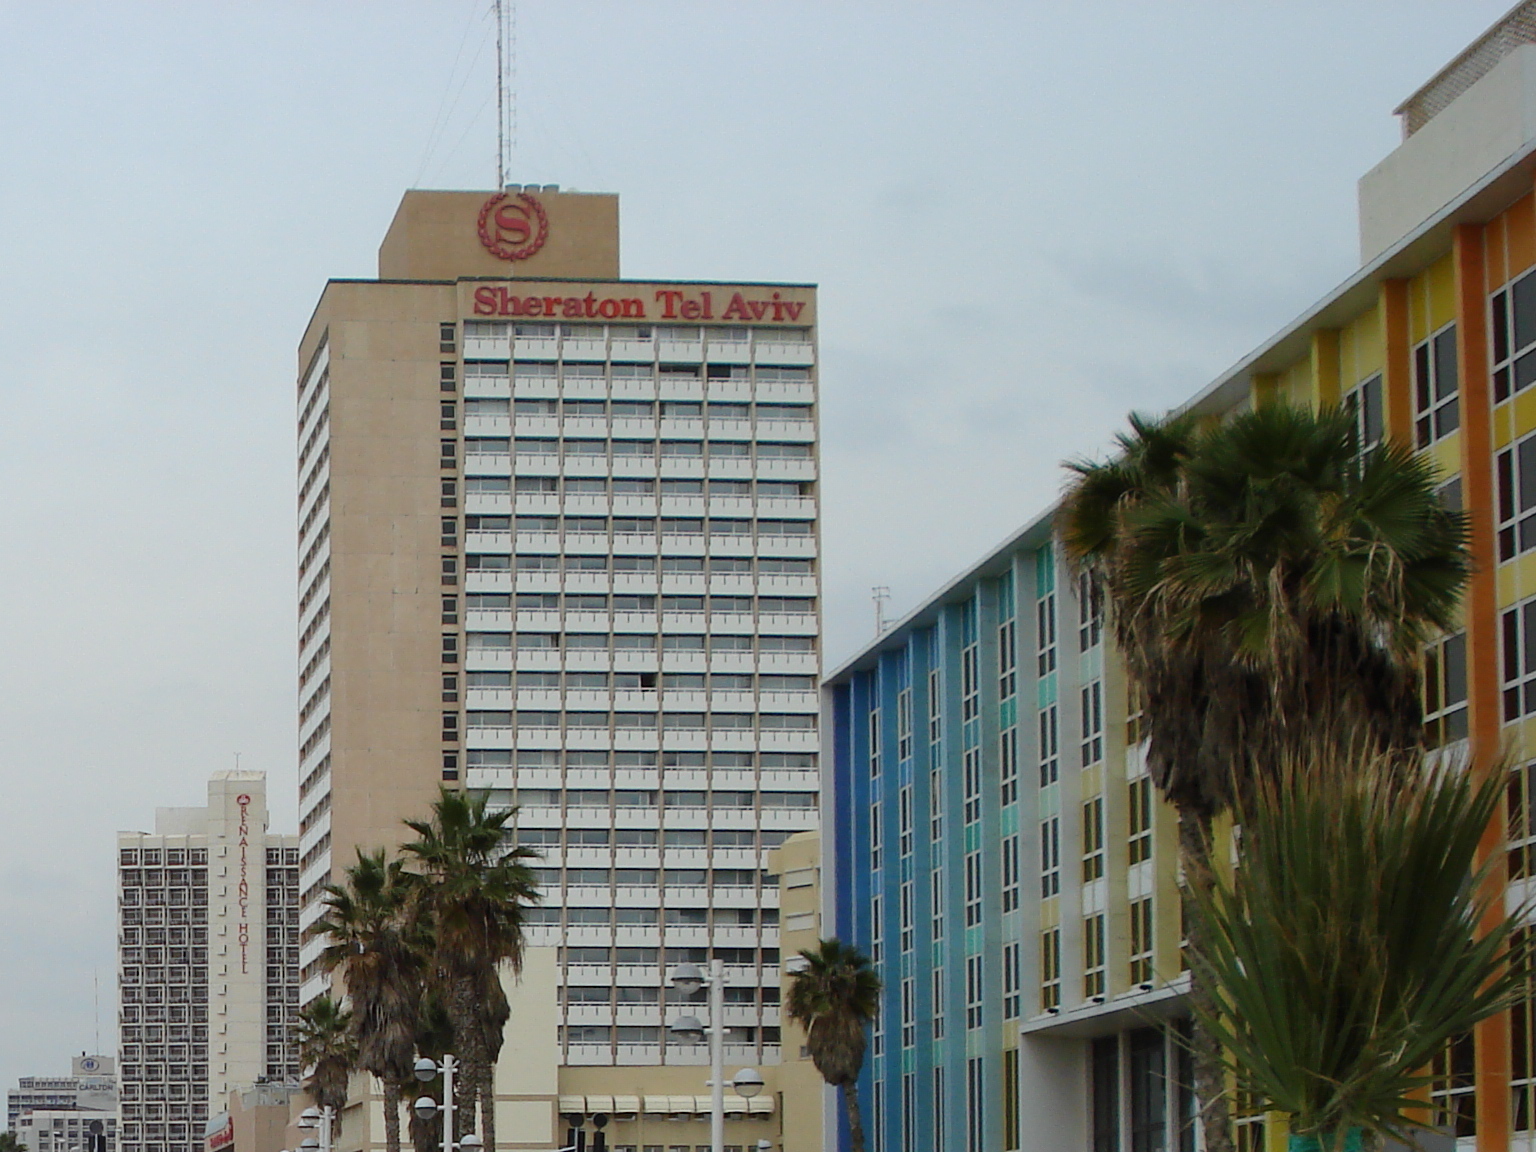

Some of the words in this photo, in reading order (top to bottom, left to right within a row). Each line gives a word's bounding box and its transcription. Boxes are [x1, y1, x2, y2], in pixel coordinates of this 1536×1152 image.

[495, 204, 531, 245] S
[474, 286, 646, 318] Sheraton
[655, 290, 714, 320] Tel
[721, 291, 807, 321] Aviv
[238, 805, 249, 917] RENAISSANCE
[238, 923, 249, 974] HOTEL
